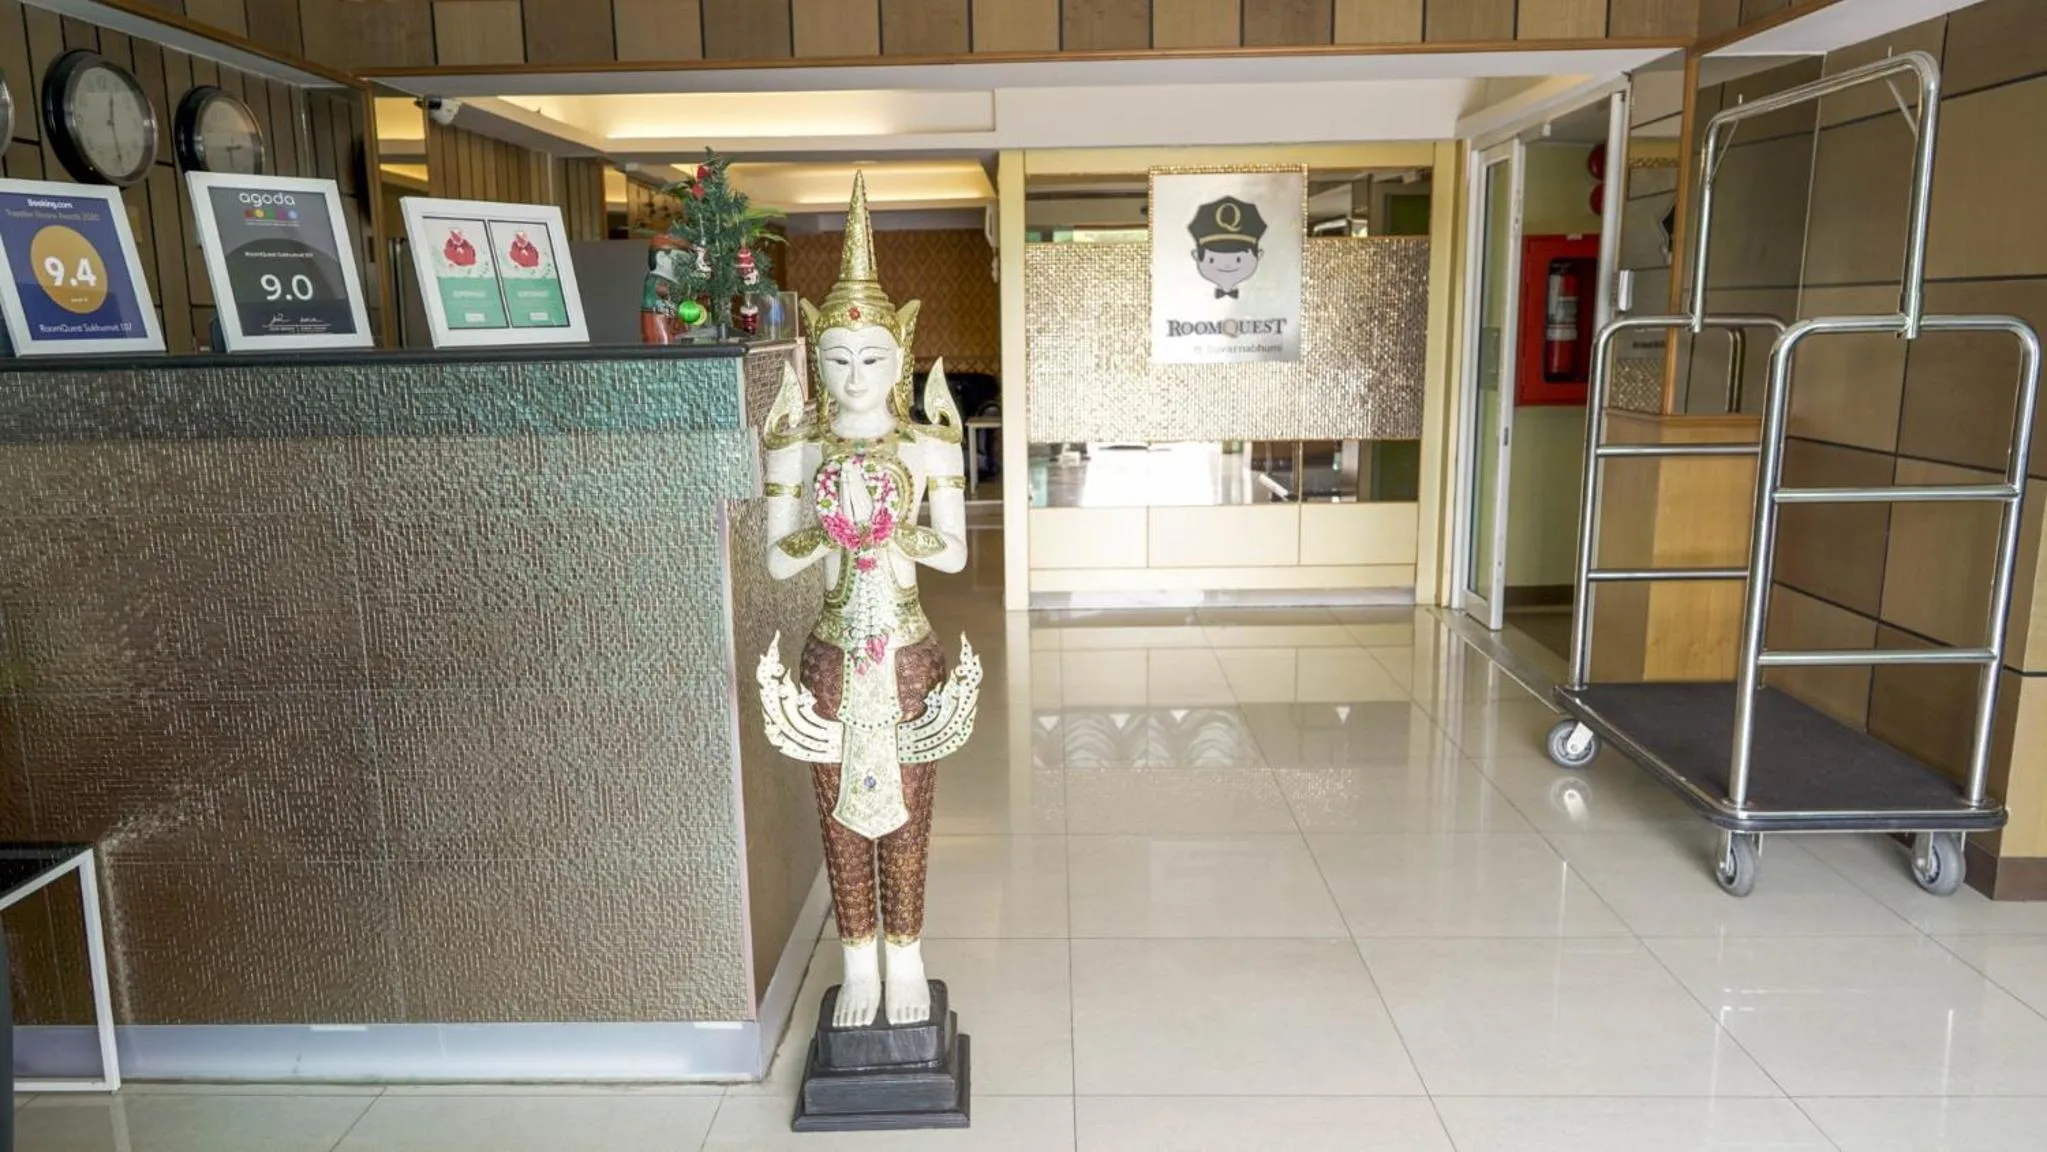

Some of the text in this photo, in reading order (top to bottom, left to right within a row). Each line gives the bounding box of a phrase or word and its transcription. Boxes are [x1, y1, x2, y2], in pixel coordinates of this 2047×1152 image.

[27, 198, 73, 209] Booking.com
[239, 192, 295, 207] agoda
[1215, 203, 1242, 231] Q
[44, 256, 97, 287] 9.4
[260, 274, 313, 301] 9.0
